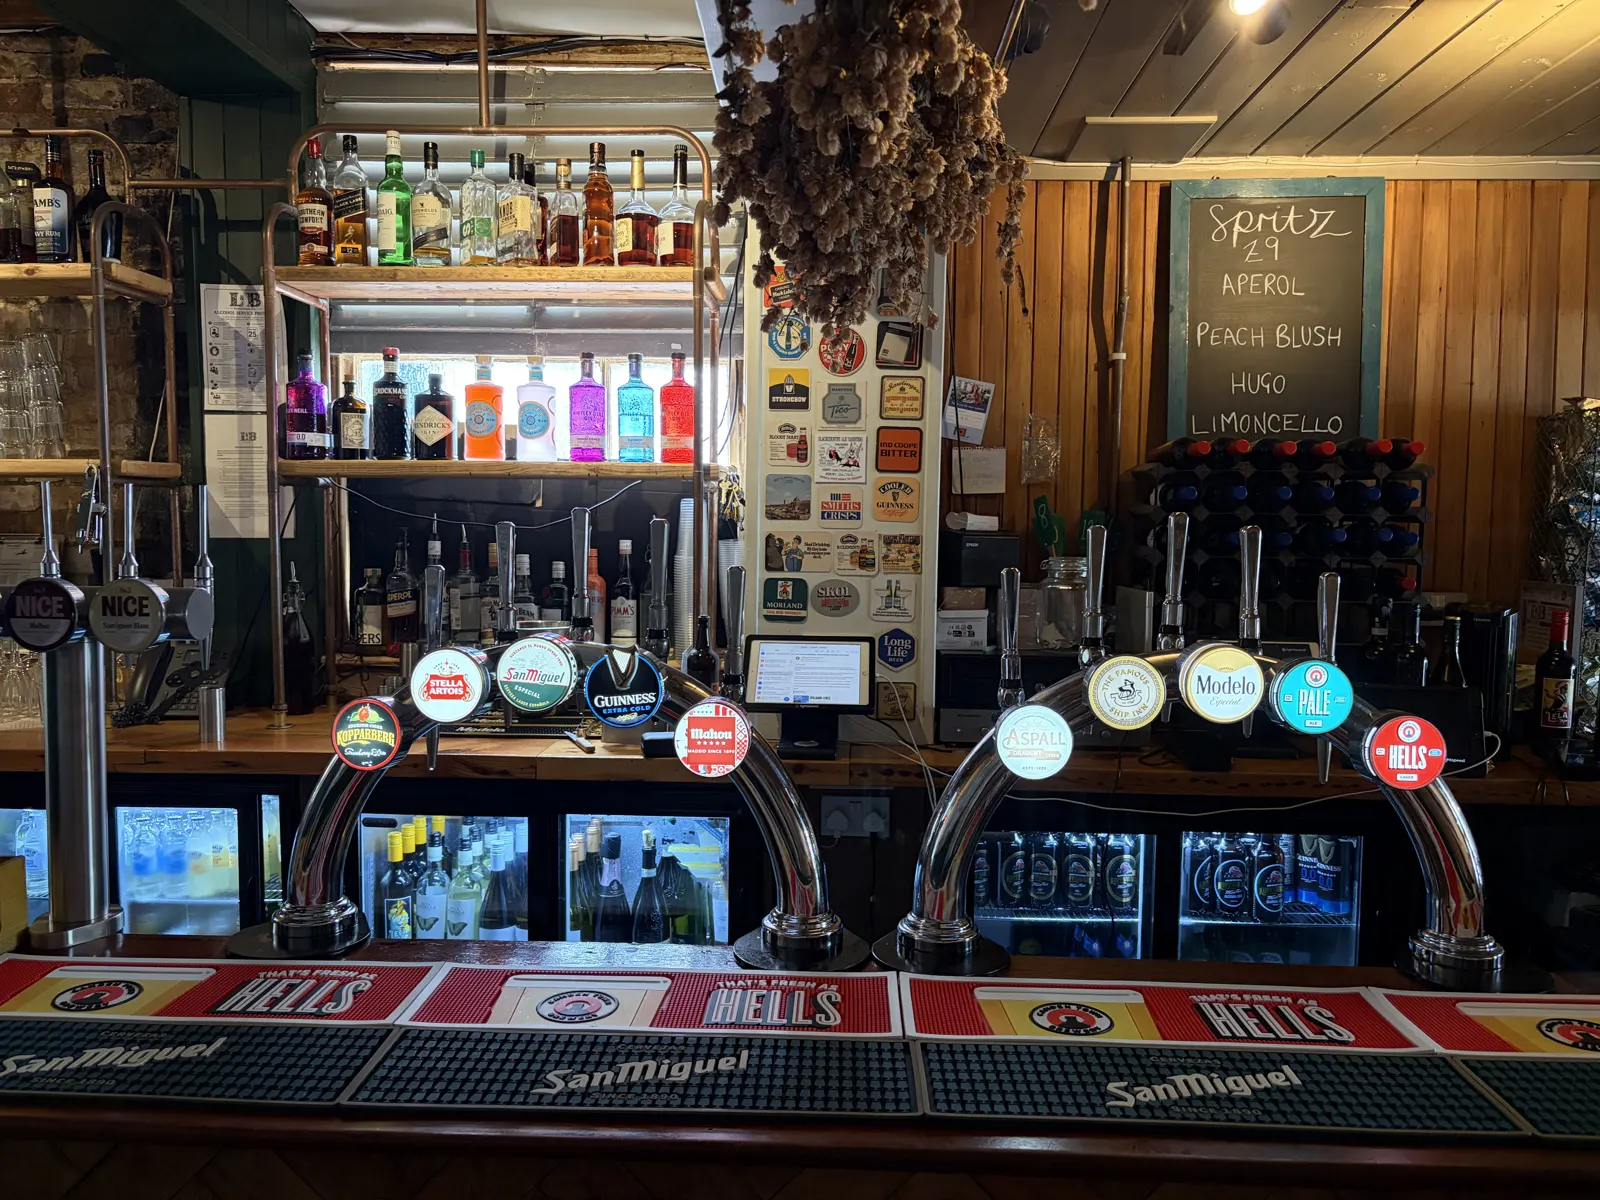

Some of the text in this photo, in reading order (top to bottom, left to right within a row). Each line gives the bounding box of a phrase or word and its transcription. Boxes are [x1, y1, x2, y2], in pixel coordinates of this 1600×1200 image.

[33, 197, 61, 209] AMB'S
[1209, 204, 1352, 247] Spritz
[1222, 273, 1305, 296] APEROL
[1197, 322, 1341, 348] PEACH BLUSH
[1231, 371, 1286, 395] HUGO
[1192, 411, 1342, 434] LIMONCELLO
[880, 449, 917, 458] BITTER
[879, 482, 912, 495] COOLED
[821, 502, 860, 510] SMITHS
[876, 501, 914, 509] GUINNESS
[824, 511, 858, 520] CRISPS
[817, 586, 851, 597] SKOL
[15, 595, 65, 617] NICE
[101, 595, 150, 617] NICE
[611, 604, 635, 616] PIMM'S
[520, 608, 535, 619] BEAM
[131, 621, 150, 629] Blanc
[883, 635, 912, 649] Long
[886, 646, 908, 657] Life
[1102, 669, 1150, 691] THE FAMOUS
[1196, 675, 1255, 695] Modelo
[429, 687, 464, 695] ARTOIS
[514, 685, 541, 699] ESPECIAL
[594, 692, 657, 708] GUINNESS
[1298, 688, 1331, 716] PALE
[1109, 704, 1149, 718] SHIP INN
[337, 729, 395, 747] KOPPARBERG
[690, 728, 733, 740] Mahou
[1002, 728, 1066, 750] ASPALL
[1389, 745, 1428, 770] HELLS
[258, 969, 311, 980] THAT'S
[312, 969, 358, 978] FRESH
[716, 979, 839, 992] THAT'S FRESH AS
[210, 979, 373, 1015] HELLS
[1242, 993, 1293, 1005] FRESH
[1296, 998, 1318, 1007] AS
[705, 988, 842, 1027] HELLS
[1197, 1002, 1356, 1044] HELLS
